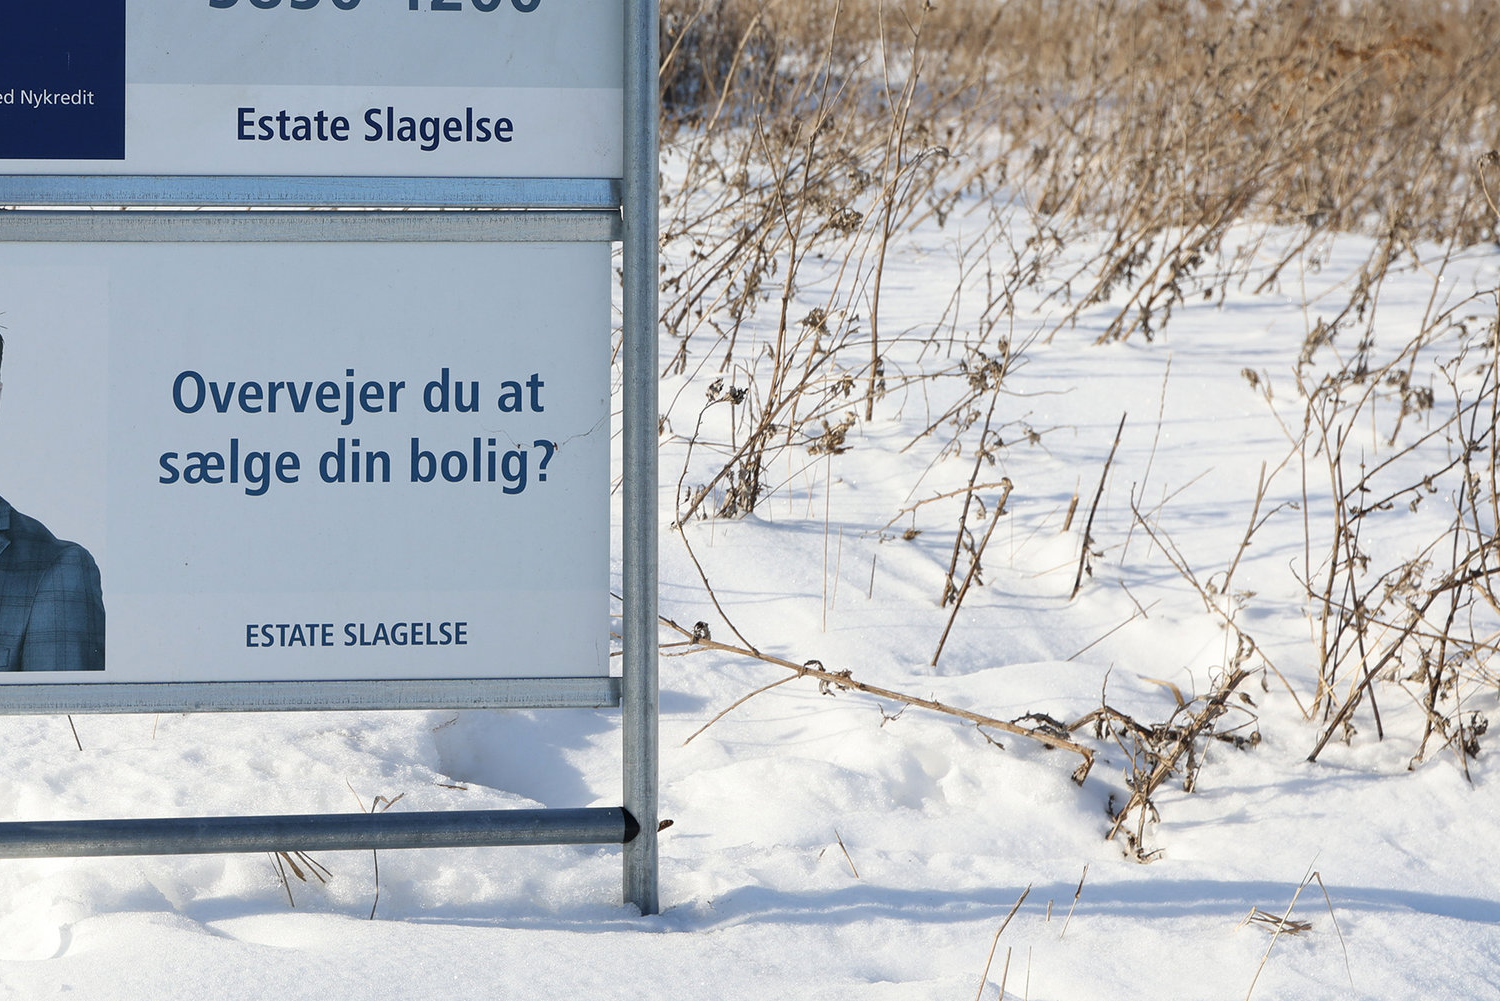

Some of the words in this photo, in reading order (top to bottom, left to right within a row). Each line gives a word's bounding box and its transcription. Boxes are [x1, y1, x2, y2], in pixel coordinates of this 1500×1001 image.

[20, 89, 95, 109] Nykredit
[237, 107, 350, 142] Estate
[364, 106, 514, 152] Slagelse
[172, 368, 406, 426] Overvejer
[423, 367, 480, 413] du
[497, 372, 545, 413] at
[159, 438, 301, 497] sælge
[318, 437, 391, 484] din
[410, 438, 554, 495] bolig?
[246, 623, 334, 648] ESTATE
[344, 621, 468, 647] SLAGELSE
